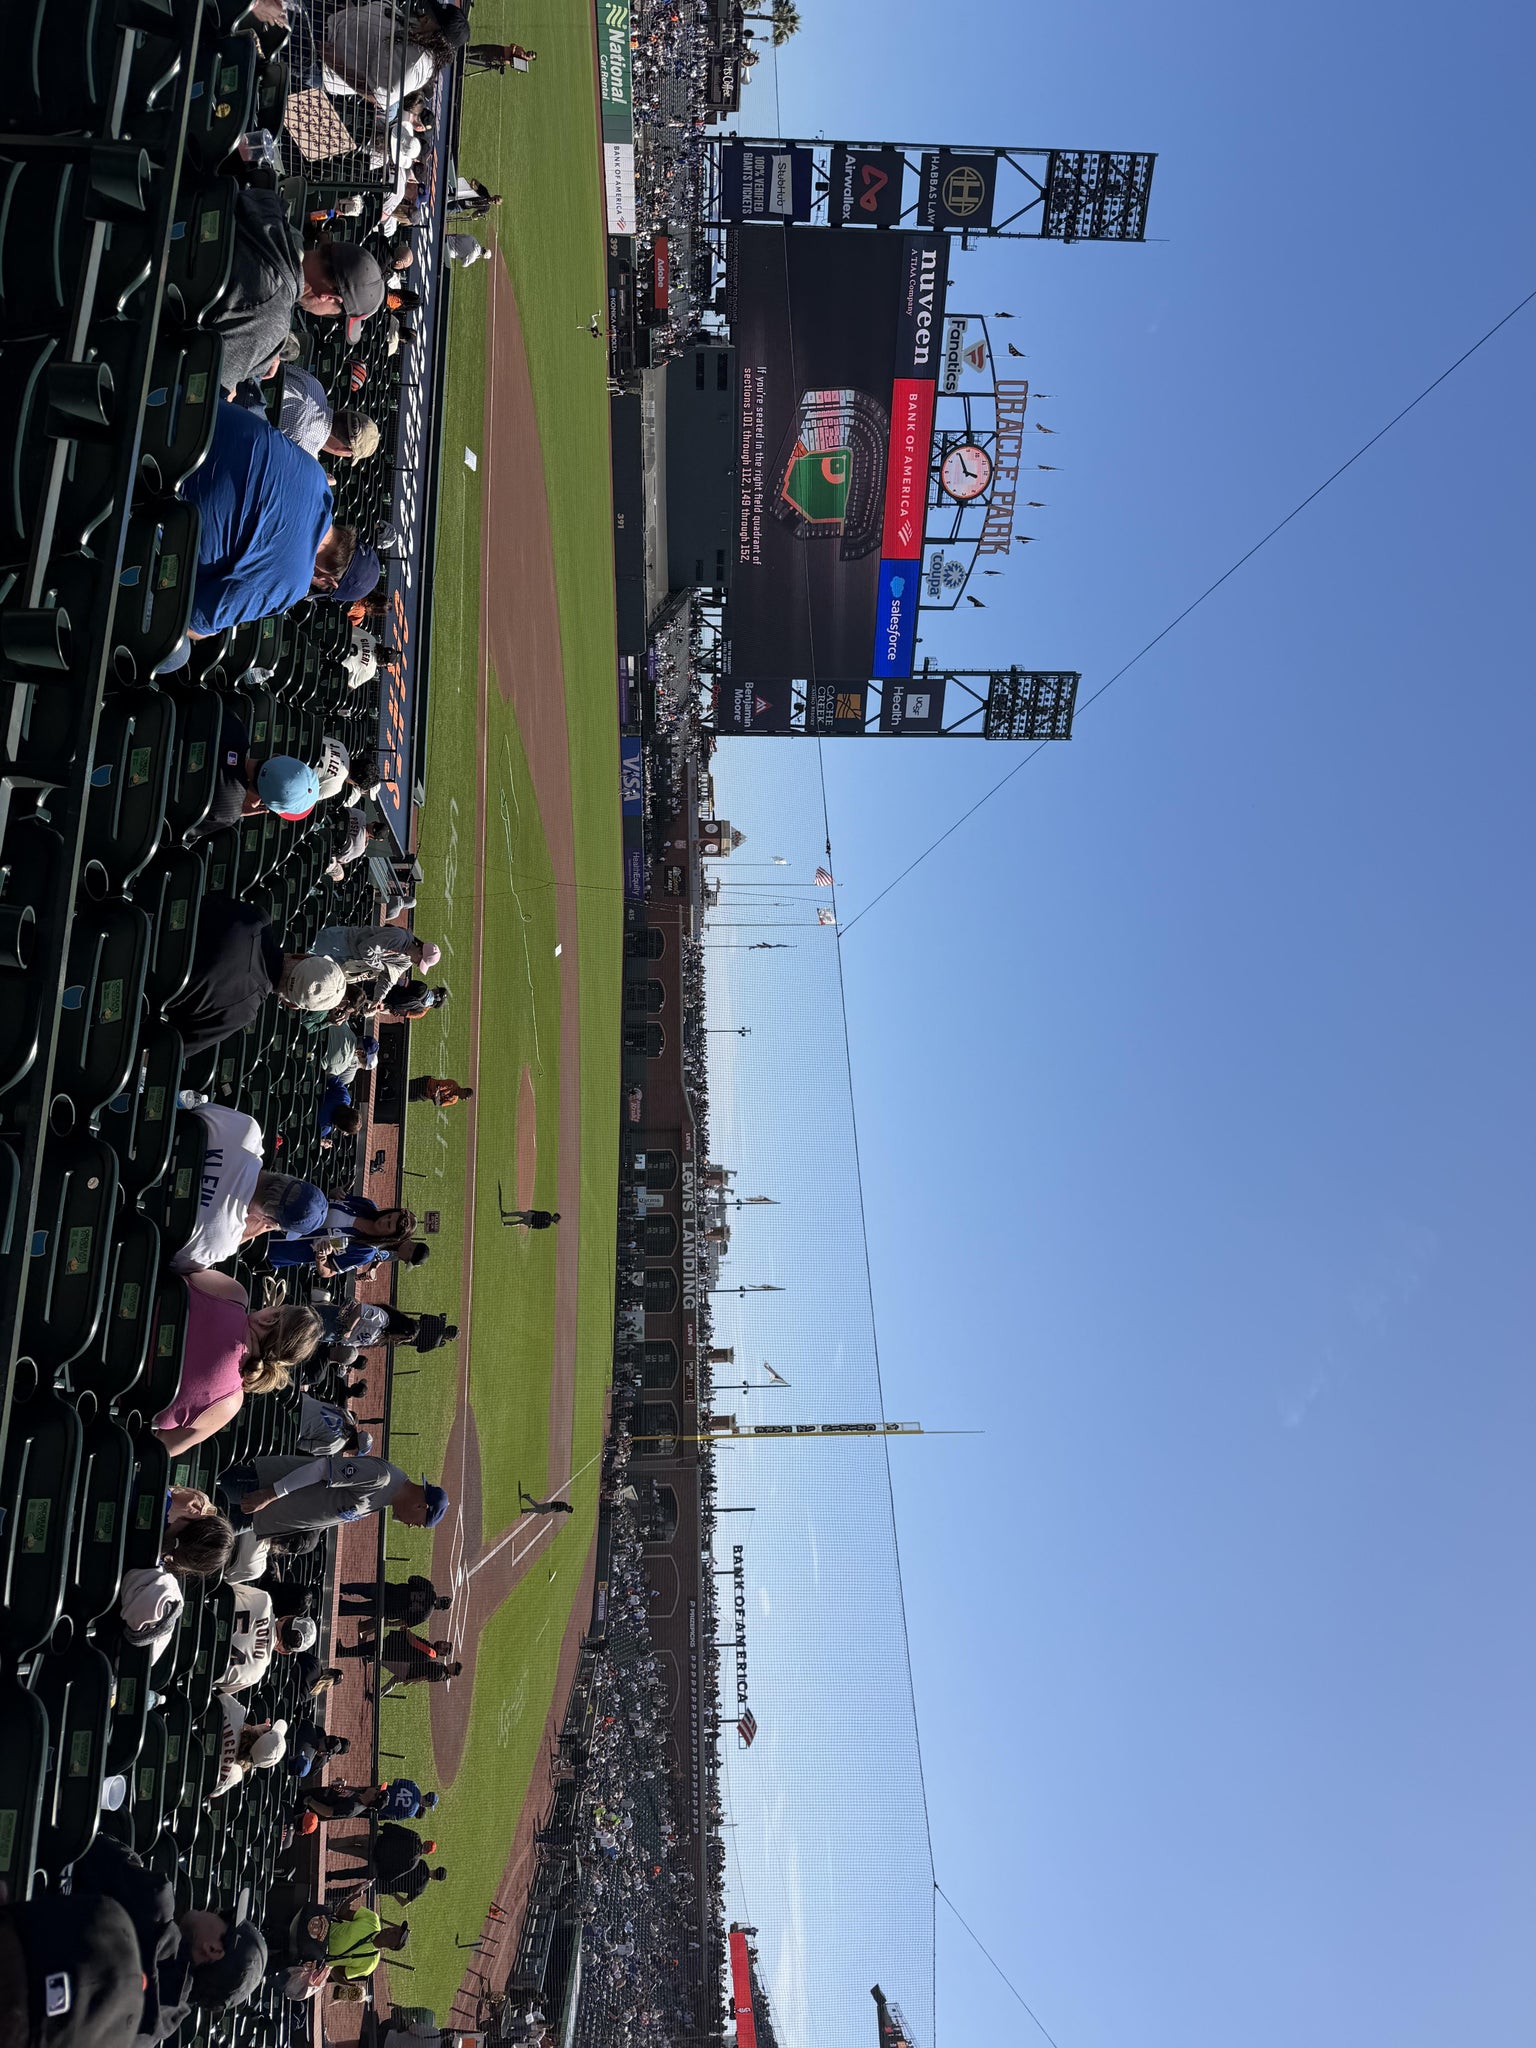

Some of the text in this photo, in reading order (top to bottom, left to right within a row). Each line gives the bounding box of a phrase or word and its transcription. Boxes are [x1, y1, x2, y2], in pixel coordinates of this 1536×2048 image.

[600, 54, 610, 100] Car Rental
[608, 28, 627, 104] National
[722, 76, 734, 97] Coffee
[613, 146, 623, 215] BANK OF AMERICA
[741, 152, 753, 214] GIANTS TICKETS
[754, 156, 765, 212] 100% VERIFIED
[777, 162, 787, 206] StubHub
[841, 155, 856, 219] Airwallex
[927, 156, 940, 224] HABBAS LAW
[610, 238, 618, 257] 399
[657, 258, 665, 288] Adobe
[906, 279, 915, 316] Company
[914, 250, 938, 365] nuveen
[757, 366, 766, 374] If
[945, 320, 965, 391] Fanatics
[744, 368, 752, 408] sections
[755, 376, 766, 404] you're
[743, 411, 752, 427] 101
[756, 407, 764, 438] seated
[741, 431, 752, 465] through
[755, 452, 764, 466] the
[900, 393, 917, 517] BANK OF AMERICA
[977, 380, 1028, 556] ORACLE PARK
[741, 468, 751, 486] 112,
[753, 470, 763, 490] right
[742, 490, 751, 506] 149
[754, 494, 763, 512] field
[740, 509, 750, 541] through
[752, 516, 762, 553] quadrant
[753, 556, 761, 565] of
[928, 553, 944, 596] coupa
[887, 600, 902, 660] salesforce
[360, 639, 371, 667] GILBERT
[734, 689, 744, 722] Moore
[742, 682, 754, 727] Benjamin
[816, 687, 826, 723] CREEK
[825, 685, 835, 726] CACHE
[891, 687, 904, 725] Health
[912, 696, 924, 716] UCSF
[327, 743, 340, 777] J.H. LEE
[623, 755, 641, 802] VISA
[632, 852, 640, 895] HealthEquity
[435, 934, 454, 1180] Heath
[200, 1149, 224, 1208] KLEIN
[682, 1220, 695, 1310] LANDING
[253, 1617, 270, 1660] ROMO
[733, 1545, 748, 1703] BANK OF AMERICA
[221, 1716, 237, 1782] INCECUM
[395, 1788, 413, 1807] 42
